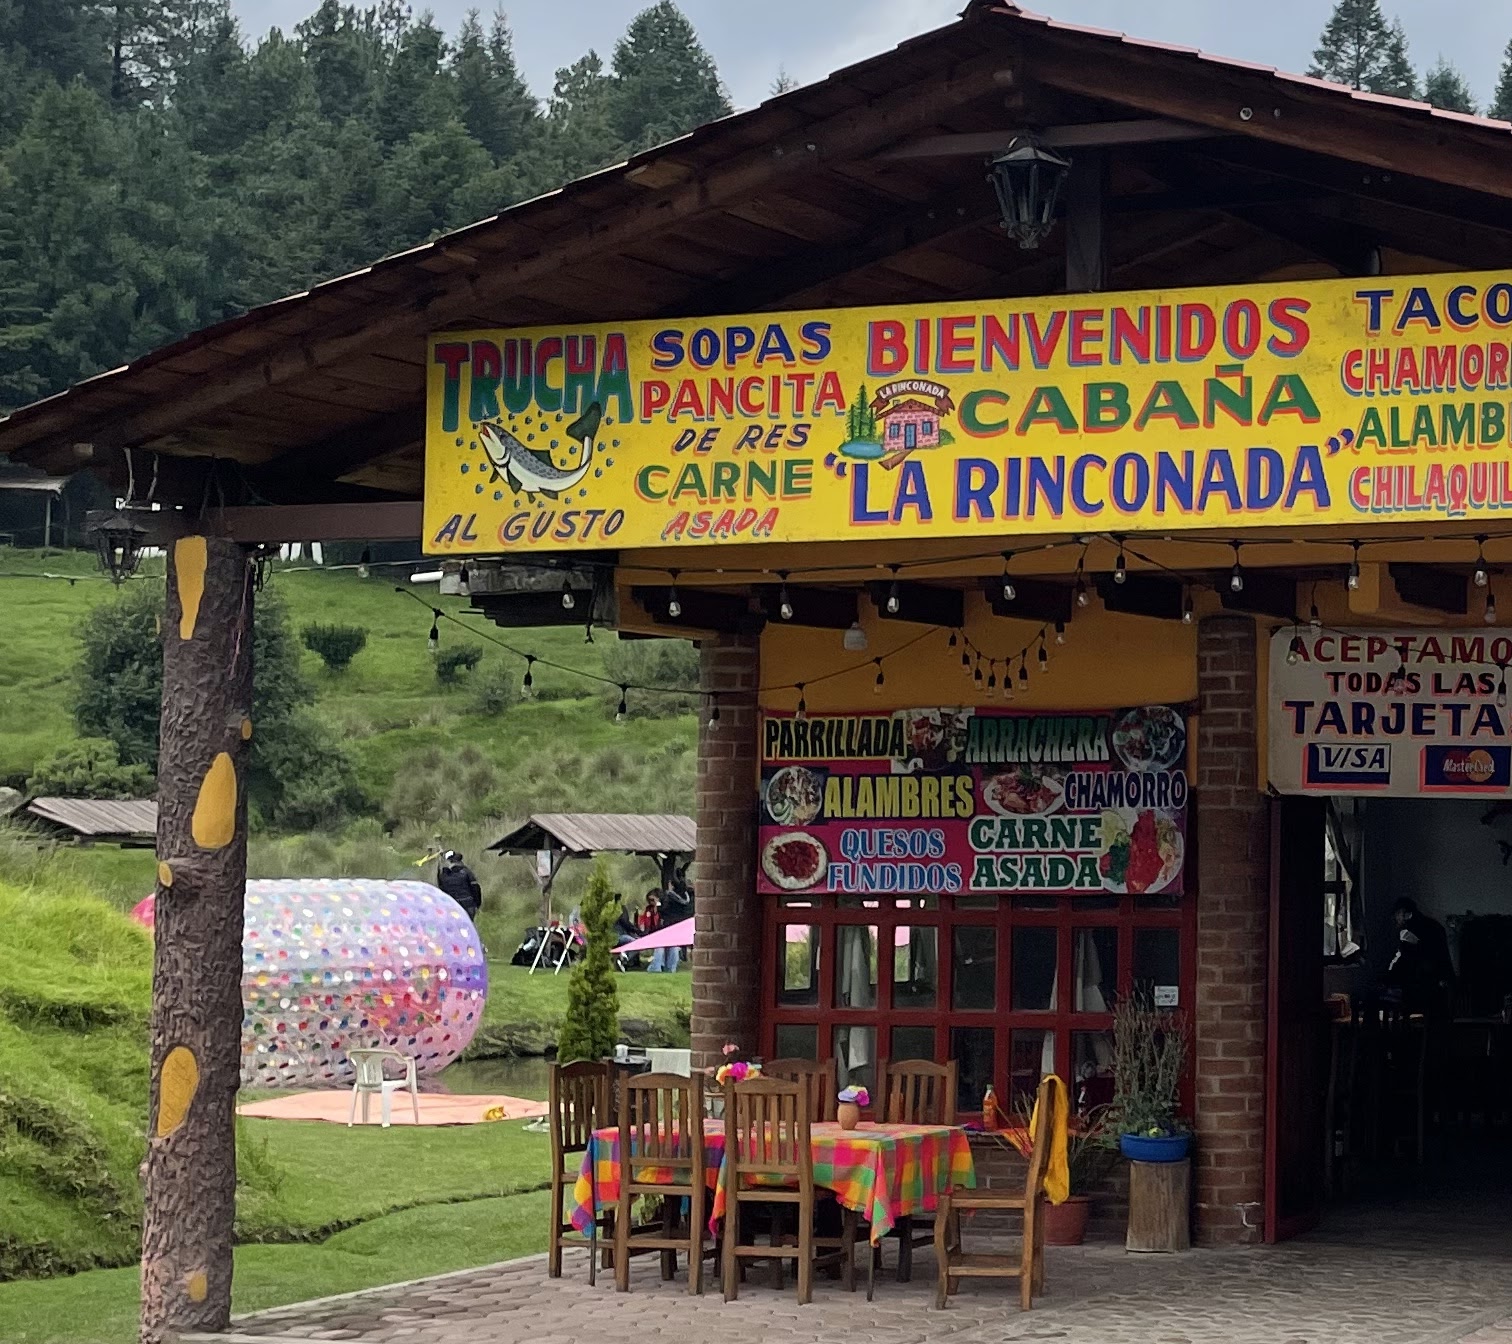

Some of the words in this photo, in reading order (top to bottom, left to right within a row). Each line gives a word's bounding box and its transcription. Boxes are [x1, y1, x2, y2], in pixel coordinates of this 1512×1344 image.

[650, 320, 832, 372] SOPAS
[866, 297, 1312, 377] BIENVENIDOS
[434, 332, 635, 433] TRUCHA
[639, 370, 847, 425] PANCITA
[892, 380, 945, 399] RINCONADA
[958, 363, 1322, 438] CABAÑA
[671, 427, 721, 455] DE
[734, 422, 812, 452] RES
[634, 458, 815, 505] CARNE
[430, 513, 478, 548] AL
[498, 507, 626, 546] GUSTO
[661, 506, 782, 541] ASADA
[1324, 671, 1422, 698] TODAS
[1431, 671, 1496, 698] LAS
[763, 715, 907, 760] PARRILLADA
[964, 713, 1111, 764] ARRACHERA
[1323, 746, 1387, 770] VISA
[823, 774, 975, 819] ALAMBRES
[1064, 770, 1189, 811] CHAMORRO
[839, 827, 946, 863] QUESOS
[967, 814, 1104, 855] CARNE
[826, 861, 963, 894] FUNDIDOS
[968, 855, 1104, 892] ASADA
